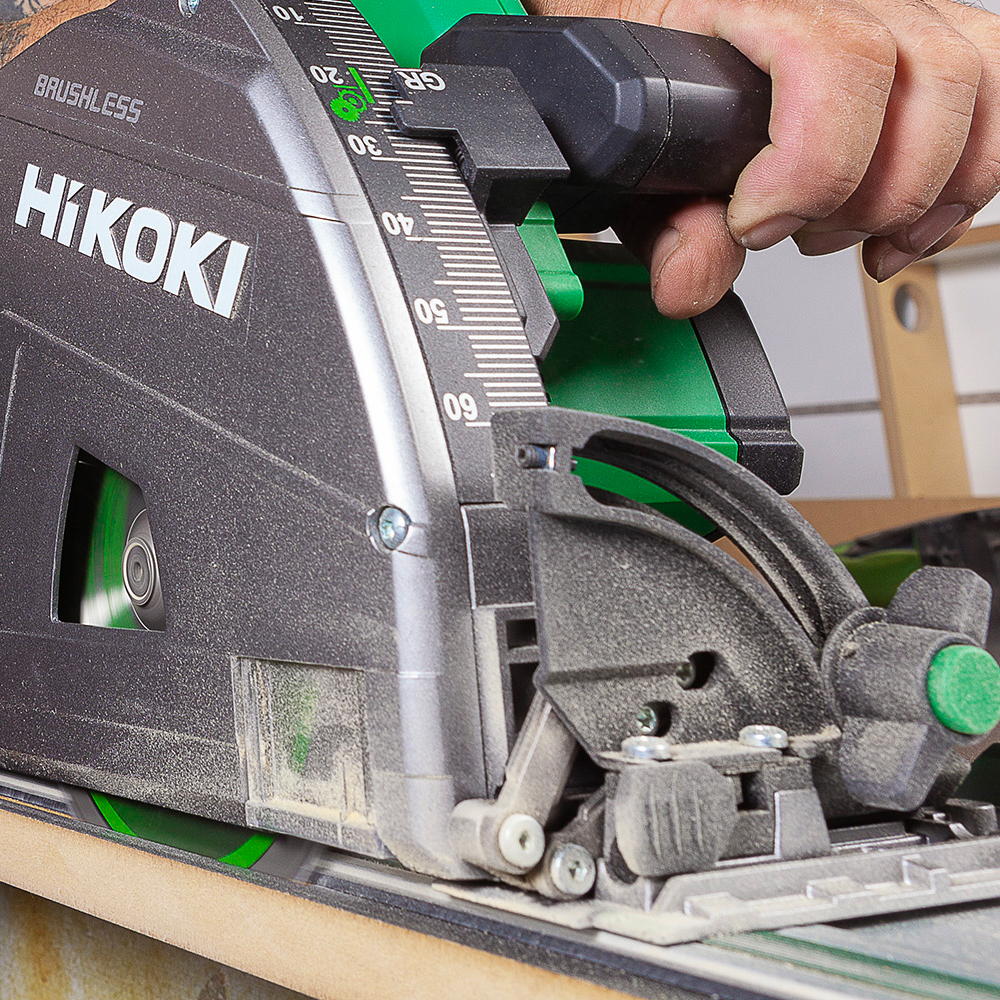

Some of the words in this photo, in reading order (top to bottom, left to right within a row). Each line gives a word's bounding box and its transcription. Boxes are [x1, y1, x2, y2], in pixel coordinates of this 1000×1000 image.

[272, 5, 304, 22] 10
[309, 65, 344, 85] 20
[396, 71, 446, 91] GR
[33, 74, 145, 124] BRUSHLESS
[347, 134, 382, 156] 30
[381, 211, 414, 236] 40
[14, 163, 251, 319] HiKOKI
[413, 297, 449, 325] 50
[442, 392, 478, 421] 60
